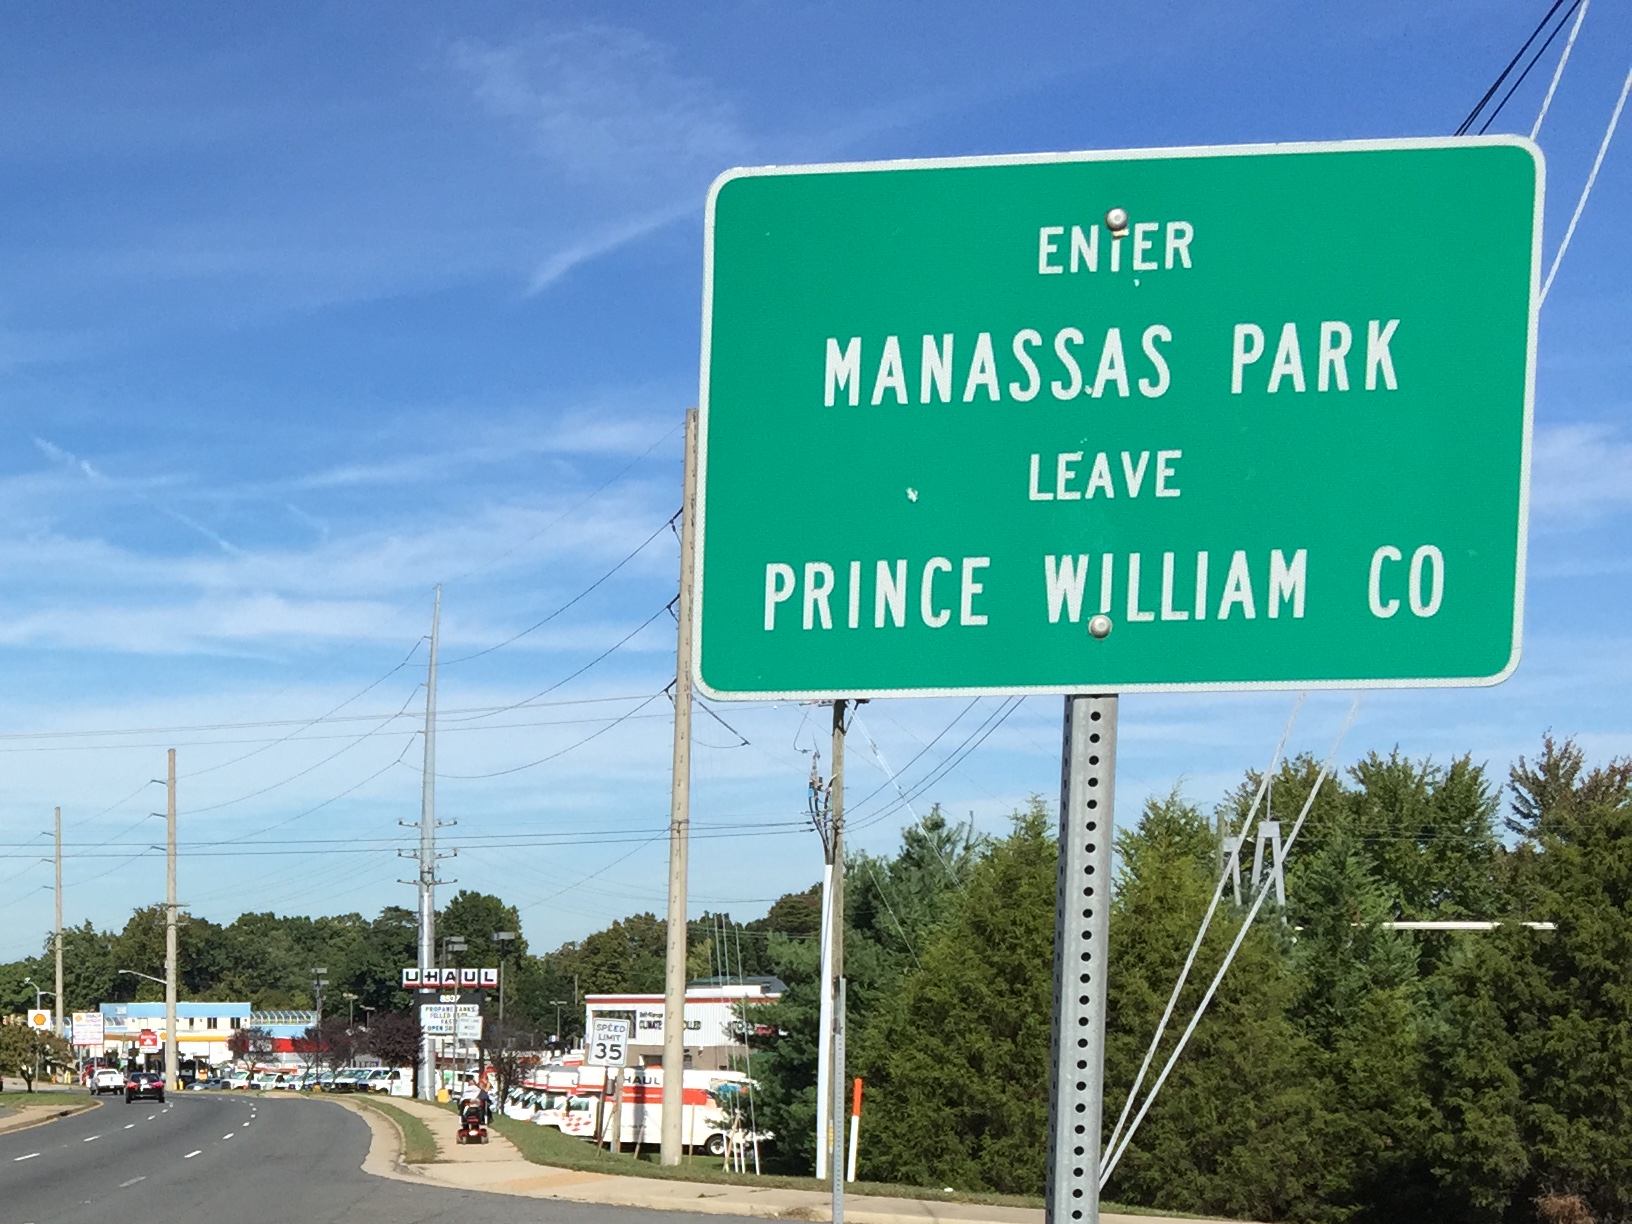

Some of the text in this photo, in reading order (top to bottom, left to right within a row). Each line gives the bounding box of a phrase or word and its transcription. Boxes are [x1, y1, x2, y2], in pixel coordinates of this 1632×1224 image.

[1038, 222, 1194, 274] ENTER
[824, 319, 1400, 407] MANASSAS PARK
[1029, 449, 1182, 501] LEAVE
[764, 544, 1444, 631] PRINCE WILLIAM CO
[594, 1042, 622, 1061] 35
[596, 1023, 626, 1033] SPEED
[598, 1033, 621, 1041] LIMIT
